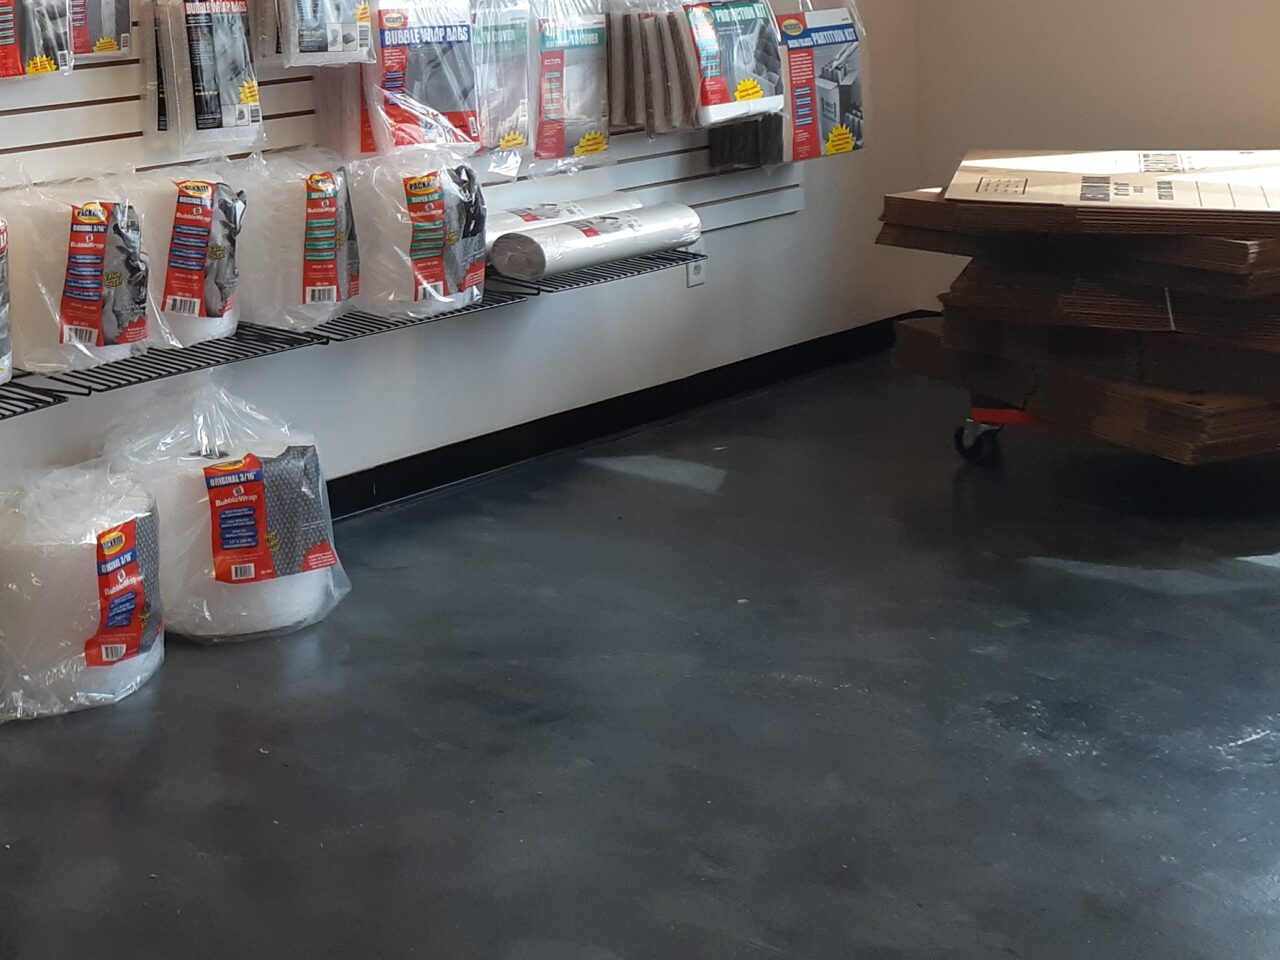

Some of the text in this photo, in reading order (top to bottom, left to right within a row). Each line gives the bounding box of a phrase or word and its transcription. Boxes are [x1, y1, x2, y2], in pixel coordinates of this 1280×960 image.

[384, 26, 468, 45] BUBBLE WRAP BAGS
[843, 28, 856, 41] KIT
[176, 212, 211, 222] BubbleWrap
[70, 241, 104, 250] BubbleWrap
[210, 471, 257, 486] ORIGINAL 3/16"
[215, 494, 258, 507] BubbleWrap
